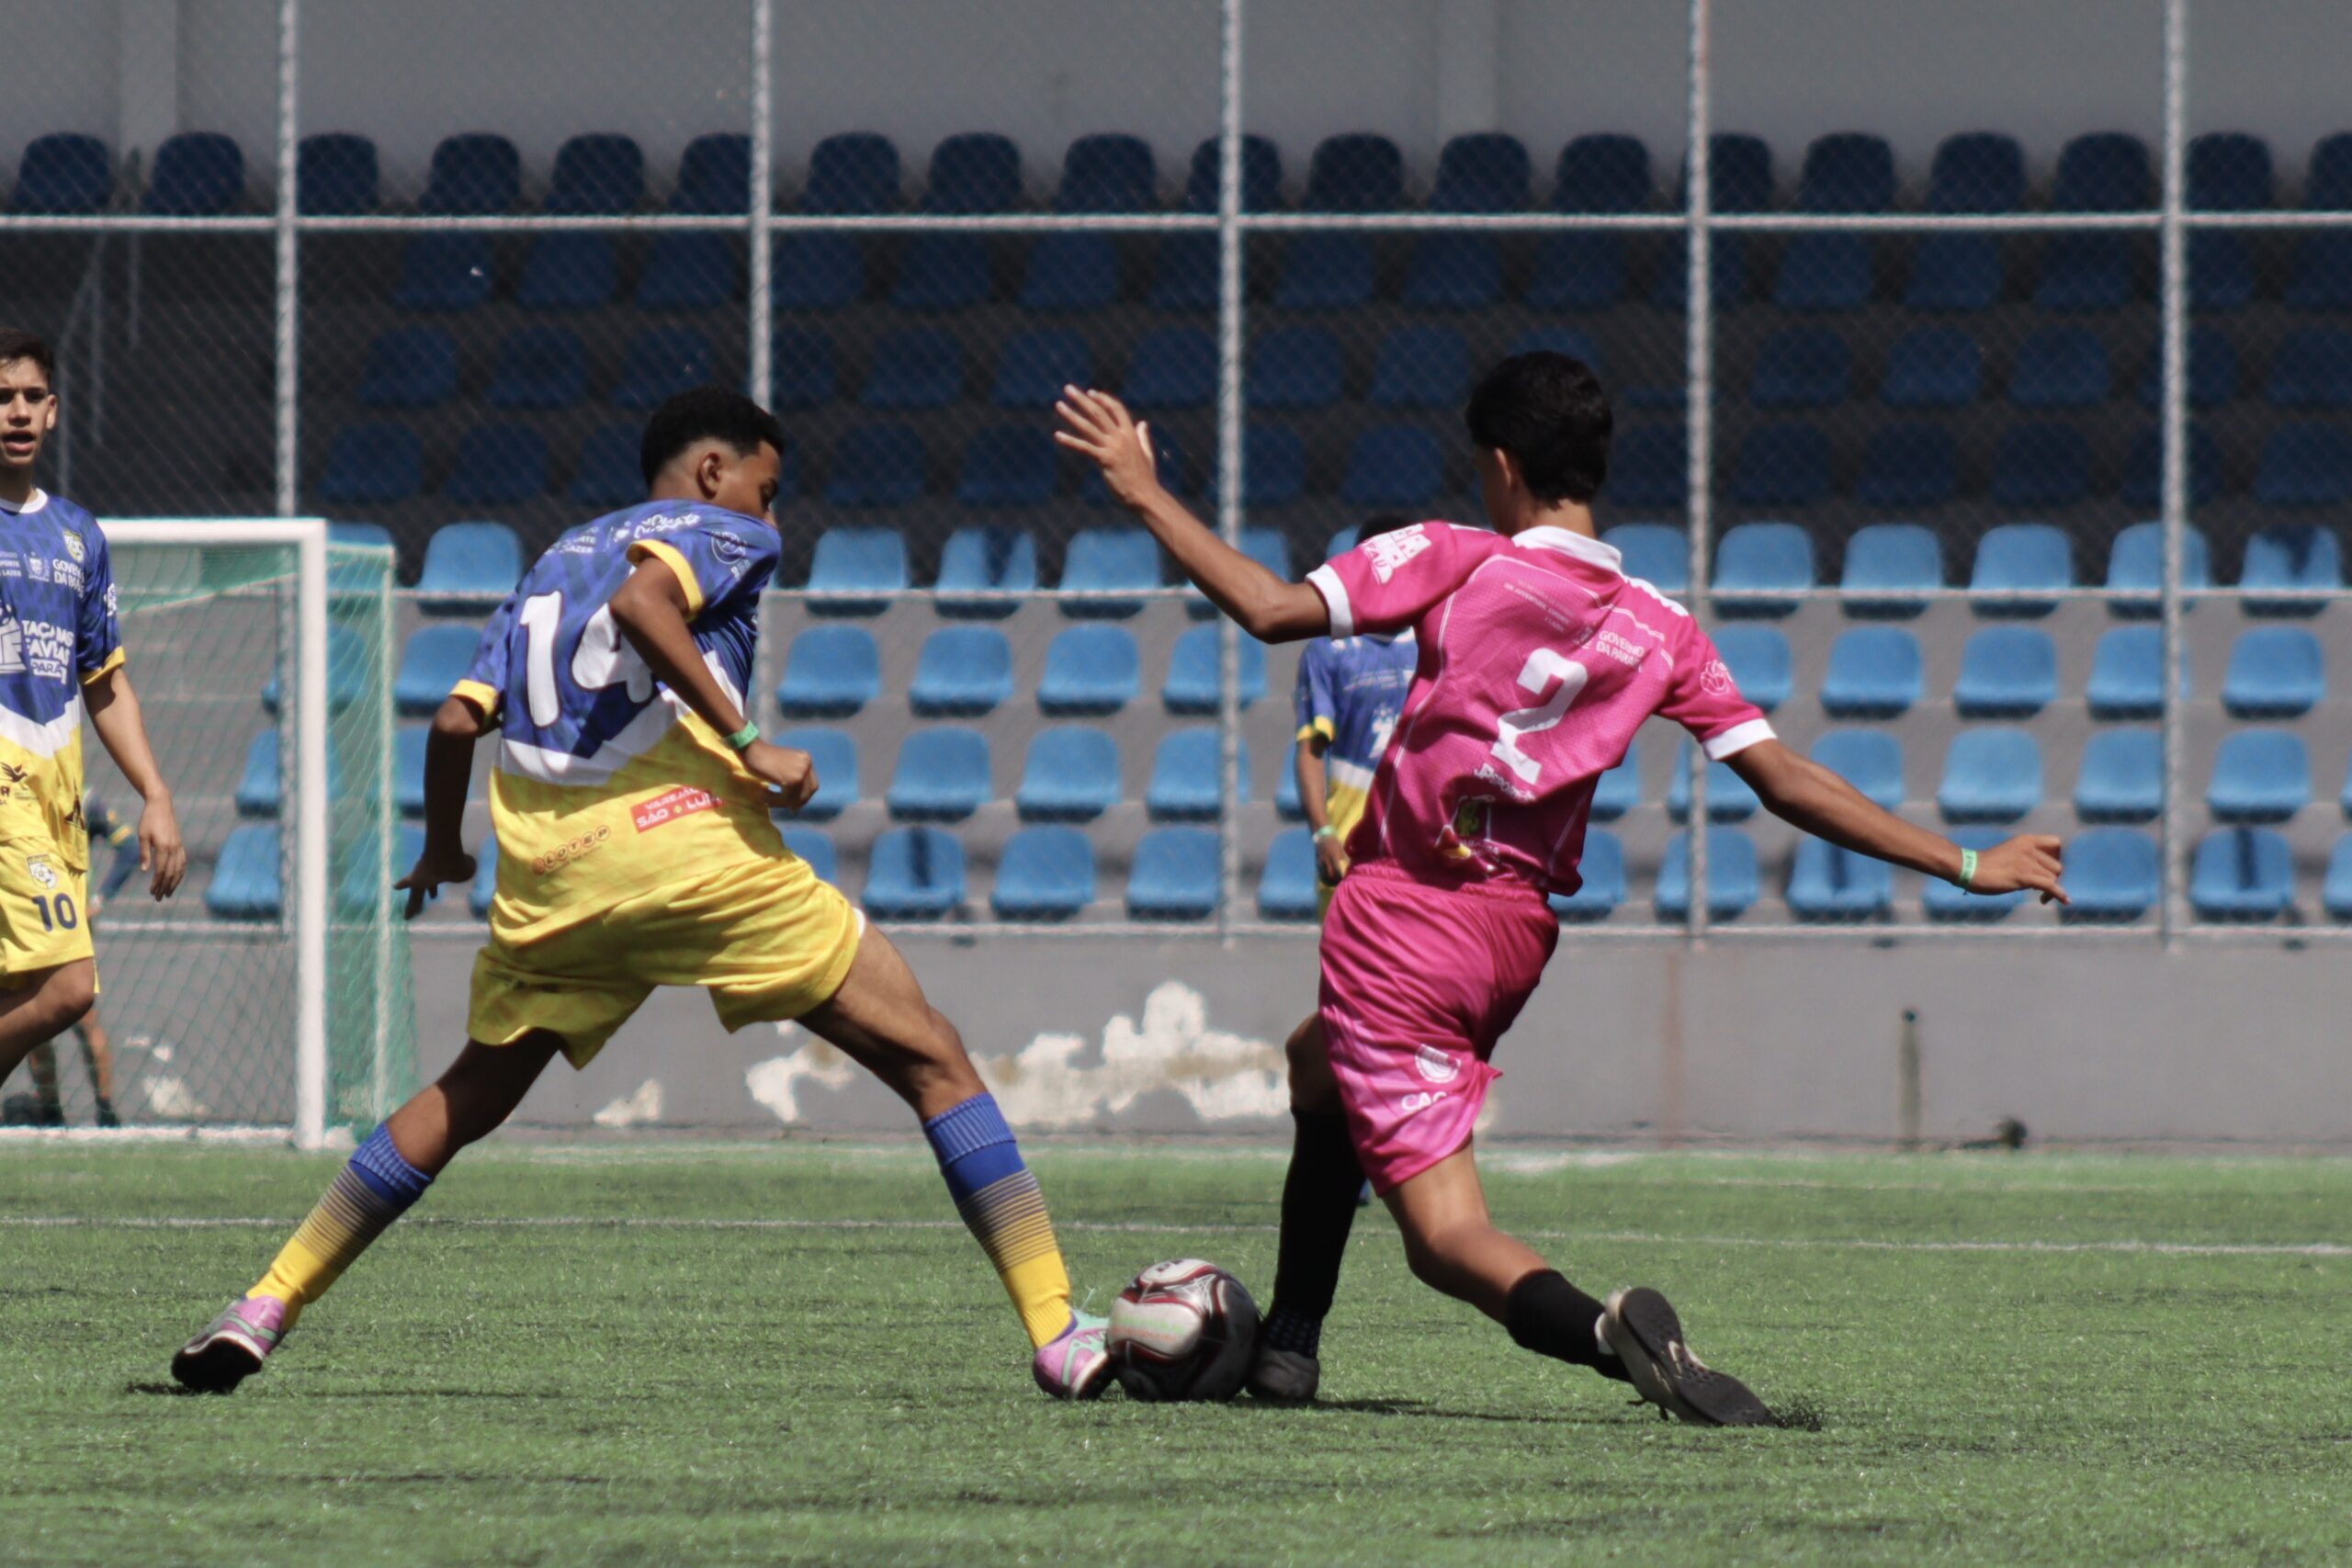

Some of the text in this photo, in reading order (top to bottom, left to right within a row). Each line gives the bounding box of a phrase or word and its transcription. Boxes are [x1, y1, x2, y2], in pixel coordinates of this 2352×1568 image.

[519, 591, 652, 728] 14
[1490, 648, 1588, 785] 2
[31, 892, 78, 933] 10
